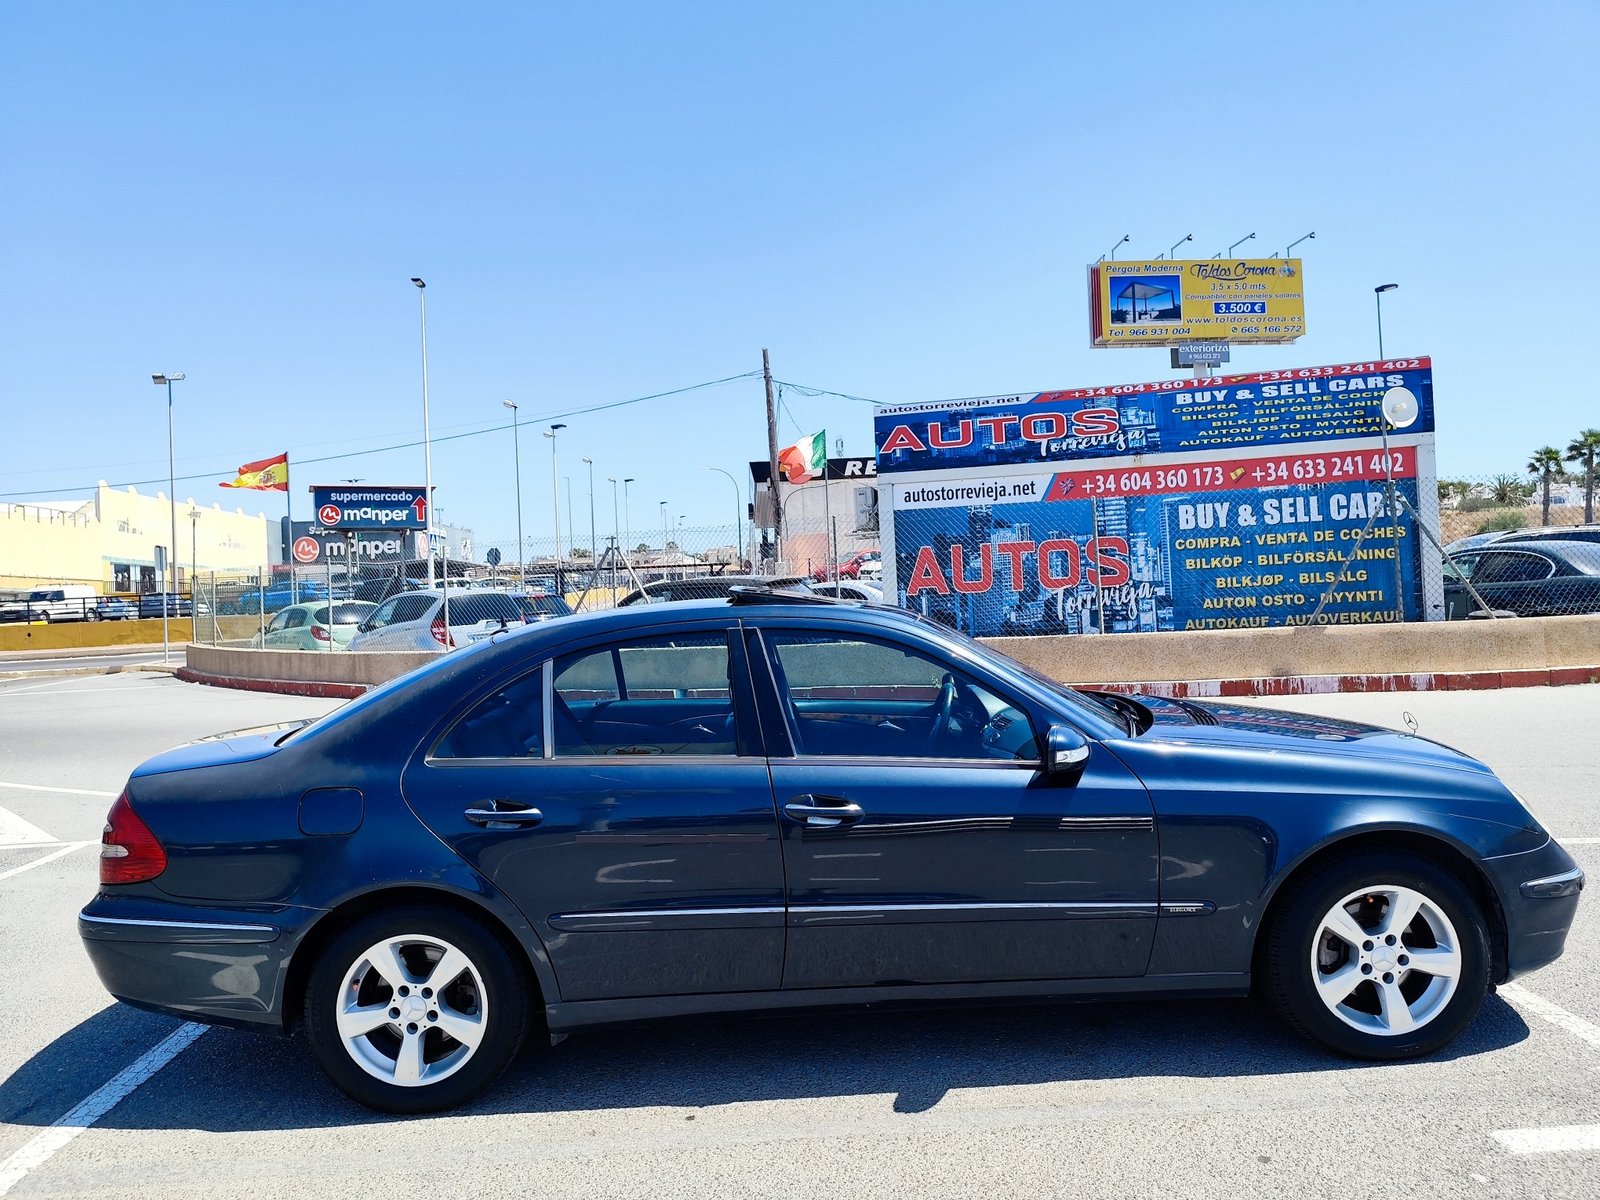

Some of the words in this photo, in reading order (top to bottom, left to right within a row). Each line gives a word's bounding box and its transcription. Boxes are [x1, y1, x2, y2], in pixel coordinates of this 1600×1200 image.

[1143, 264, 1184, 272] Moderna
[1190, 263, 1231, 279] Toldos
[1234, 262, 1277, 277] Corona
[1244, 293, 1273, 301] paneles
[1218, 303, 1251, 313] 3.500
[1254, 303, 1263, 313] €
[1186, 316, 1302, 324] www.toldoscorona.es
[1129, 328, 1148, 336] 966
[1151, 328, 1169, 336] 931
[1172, 327, 1191, 335] 004
[1241, 326, 1260, 334] 665
[1179, 343, 1229, 353] exterioriza
[1253, 371, 1294, 381] +34
[1299, 367, 1334, 378] 633
[1340, 363, 1375, 374] 241
[1383, 360, 1420, 370] 402
[1070, 388, 1107, 398] +34
[1112, 384, 1146, 394] 604
[1151, 380, 1184, 390] 360
[1190, 376, 1223, 387] 173
[1176, 390, 1229, 405] BUY
[1235, 389, 1255, 400] &
[1262, 381, 1322, 398] SELL
[1328, 374, 1404, 392] CARS
[879, 395, 1022, 414] autostorrevieja.net
[1171, 402, 1238, 414] COMPRA
[1252, 397, 1306, 406] VENTA
[1311, 394, 1332, 402] DE
[1338, 390, 1386, 399] COCH
[1181, 409, 1239, 421] BILKÖP
[1254, 399, 1382, 416] BILFÖRSÄLJNIN
[1198, 426, 1252, 436] AUTON
[1257, 423, 1300, 432] OSTO
[1316, 417, 1380, 427] MYYNTI
[1211, 416, 1279, 427] BILKJØP
[1295, 409, 1366, 420] BILSALG
[879, 408, 1120, 454] AUTOS
[1034, 430, 1145, 457] Torrevieja
[1179, 434, 1264, 447] AUTOKAUF
[1251, 461, 1289, 482] +34
[1292, 458, 1326, 478] 633
[1331, 455, 1363, 476] 241
[1369, 452, 1404, 473] 402
[1081, 474, 1116, 495] +34
[1119, 472, 1151, 492] 604
[1156, 469, 1187, 489] 360
[1192, 466, 1224, 487] 173
[330, 492, 413, 502] supermercado
[904, 480, 1036, 503] autostorrevieja.net
[343, 507, 409, 524] manper
[1178, 502, 1230, 530] BUY
[1237, 504, 1257, 527] &
[1262, 497, 1323, 524] SELL
[1329, 489, 1404, 520] CARS
[1175, 536, 1241, 550] COMPRA
[1255, 531, 1309, 545] VENTA
[1313, 530, 1335, 542] DE
[906, 535, 1130, 595] AUTOS
[1185, 554, 1243, 570] BILKÖP
[1216, 574, 1284, 588] BILKJØP
[1203, 596, 1257, 609] AUTON
[1262, 594, 1305, 607] OSTO
[1185, 616, 1270, 630] AUTOKAUF
